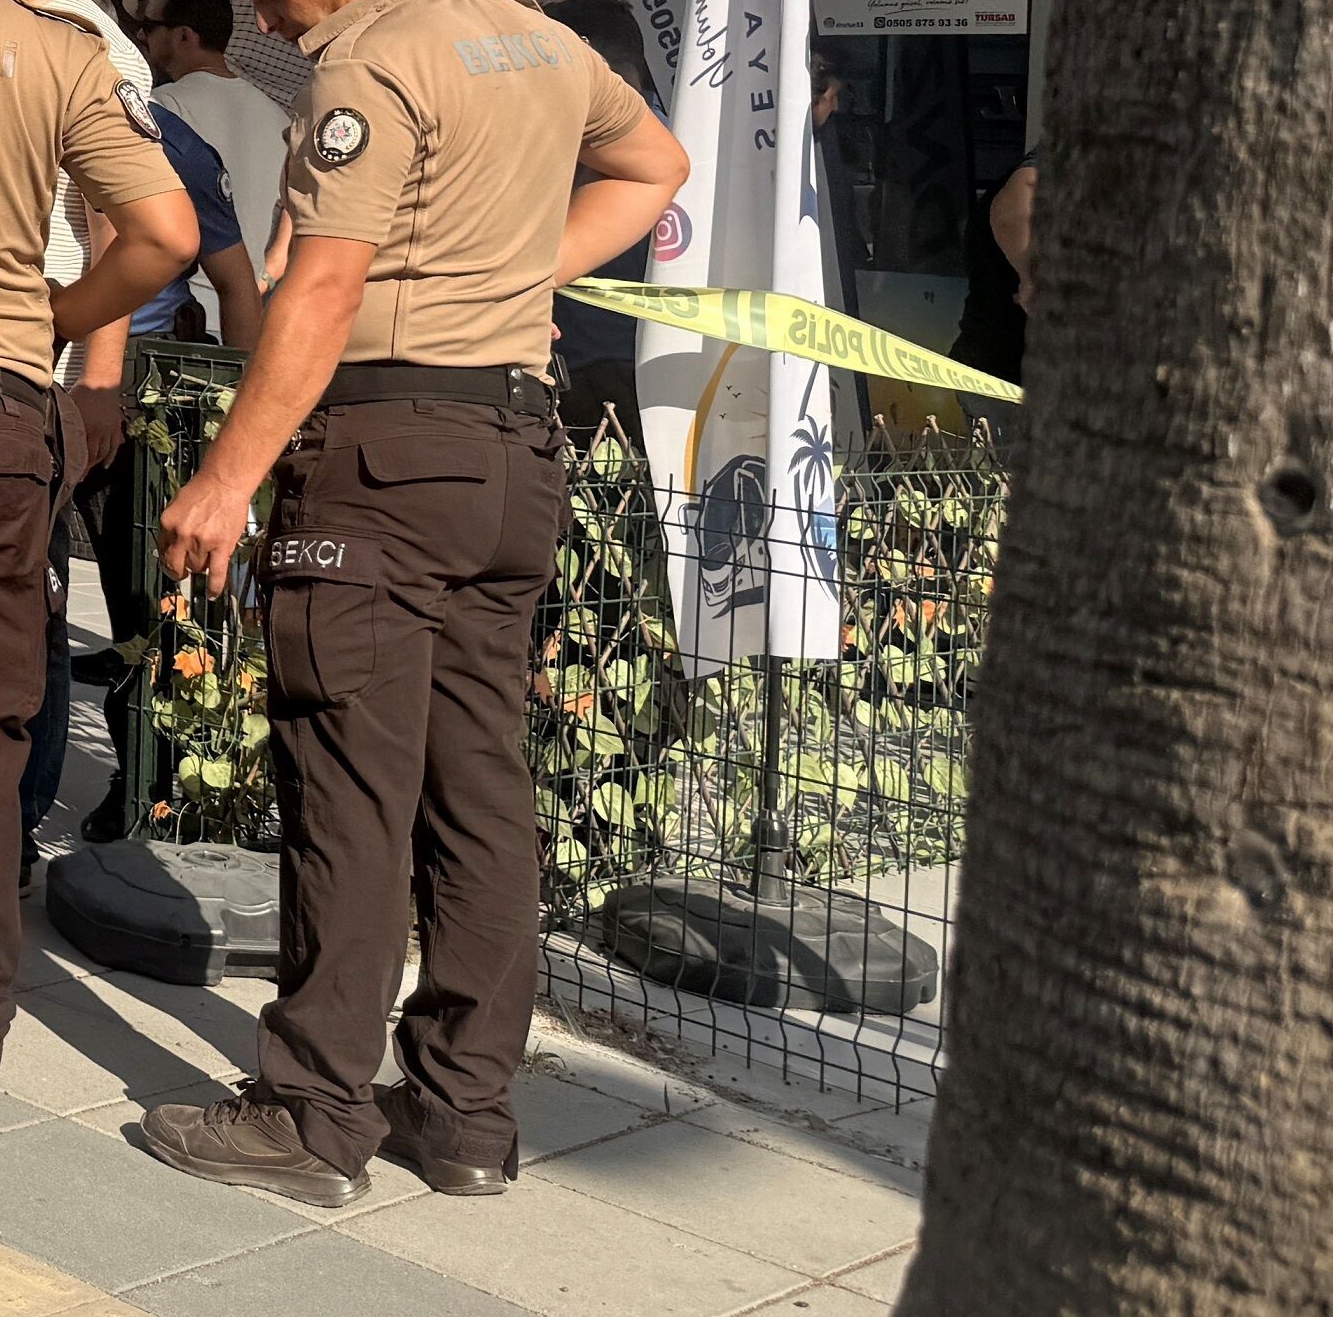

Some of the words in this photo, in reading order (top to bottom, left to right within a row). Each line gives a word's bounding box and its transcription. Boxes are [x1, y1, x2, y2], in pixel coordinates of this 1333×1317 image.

[886, 19, 913, 28] 0505
[915, 19, 935, 28] 875
[937, 18, 952, 27] 93
[954, 18, 969, 27] 36
